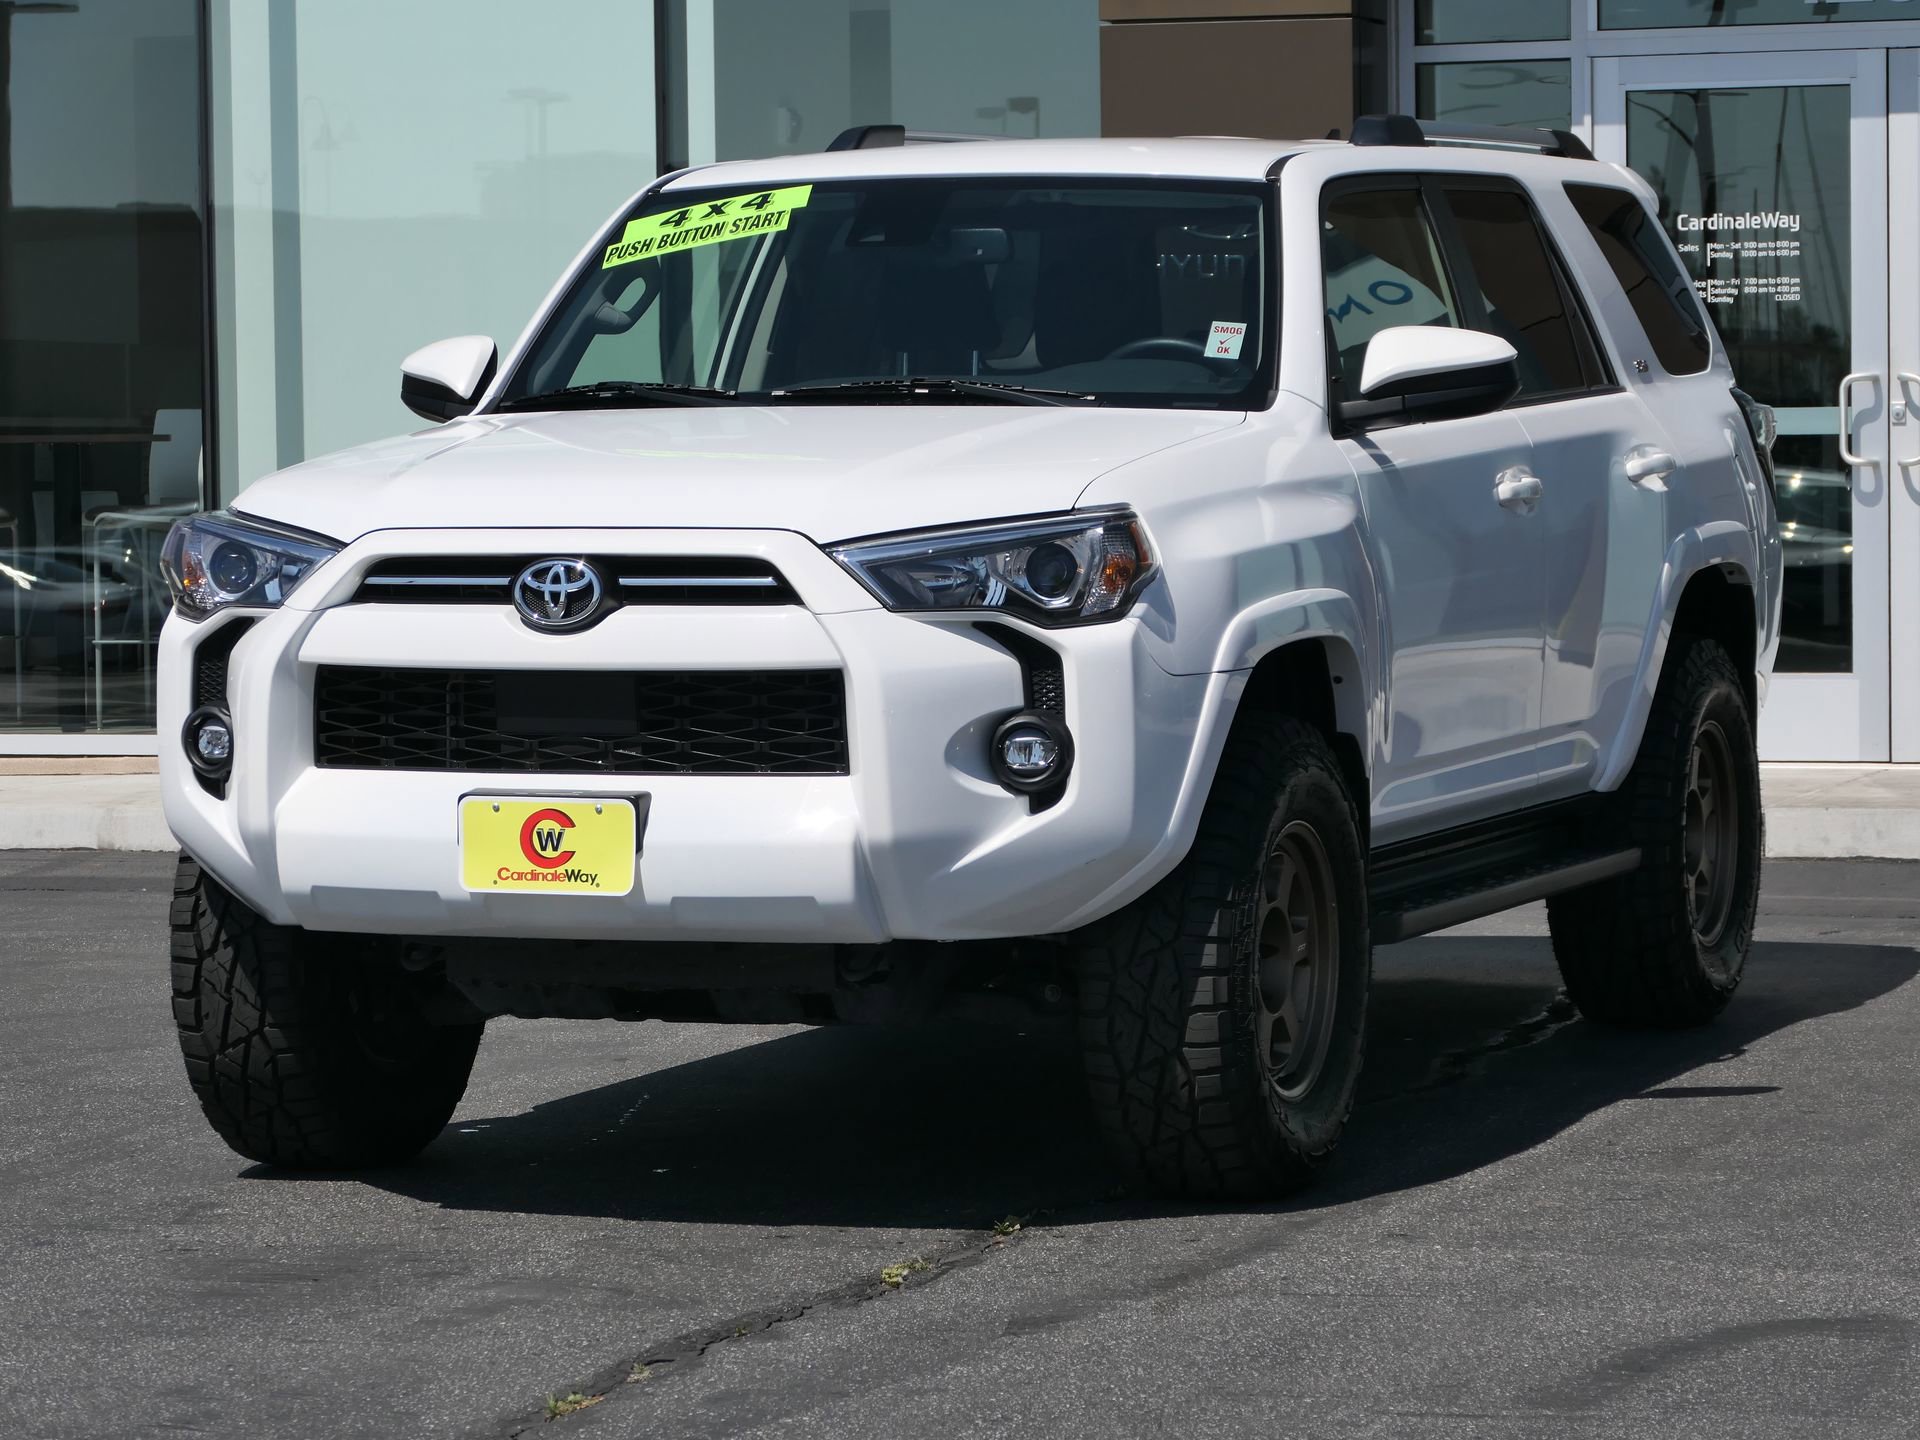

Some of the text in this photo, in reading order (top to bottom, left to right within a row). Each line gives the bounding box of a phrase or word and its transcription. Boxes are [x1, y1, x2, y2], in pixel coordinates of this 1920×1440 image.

[660, 208, 691, 228] 4
[740, 191, 775, 210] 4
[1677, 211, 1800, 232] CardinaleWay
[606, 210, 787, 263] PUSH BUTTON START
[1678, 244, 1700, 253] Sales
[1730, 242, 1741, 250] Sat
[1743, 241, 1757, 249] 9:00
[1790, 241, 1800, 249] pm
[1710, 251, 1733, 259] Sunday
[1776, 249, 1790, 257] 6:00
[1744, 277, 1758, 285] 7:00
[1776, 276, 1790, 284] 6:00
[1790, 278, 1800, 286] pm
[1710, 287, 1739, 296] Saturday
[1744, 286, 1758, 294] 8:00
[1776, 285, 1790, 293] 4:00
[1790, 286, 1800, 294] pm
[1710, 293, 1800, 304] Sunday CLOSED
[1213, 325, 1243, 336] SMOG
[1216, 346, 1230, 354] OK
[497, 867, 598, 885] CardinaleWay
